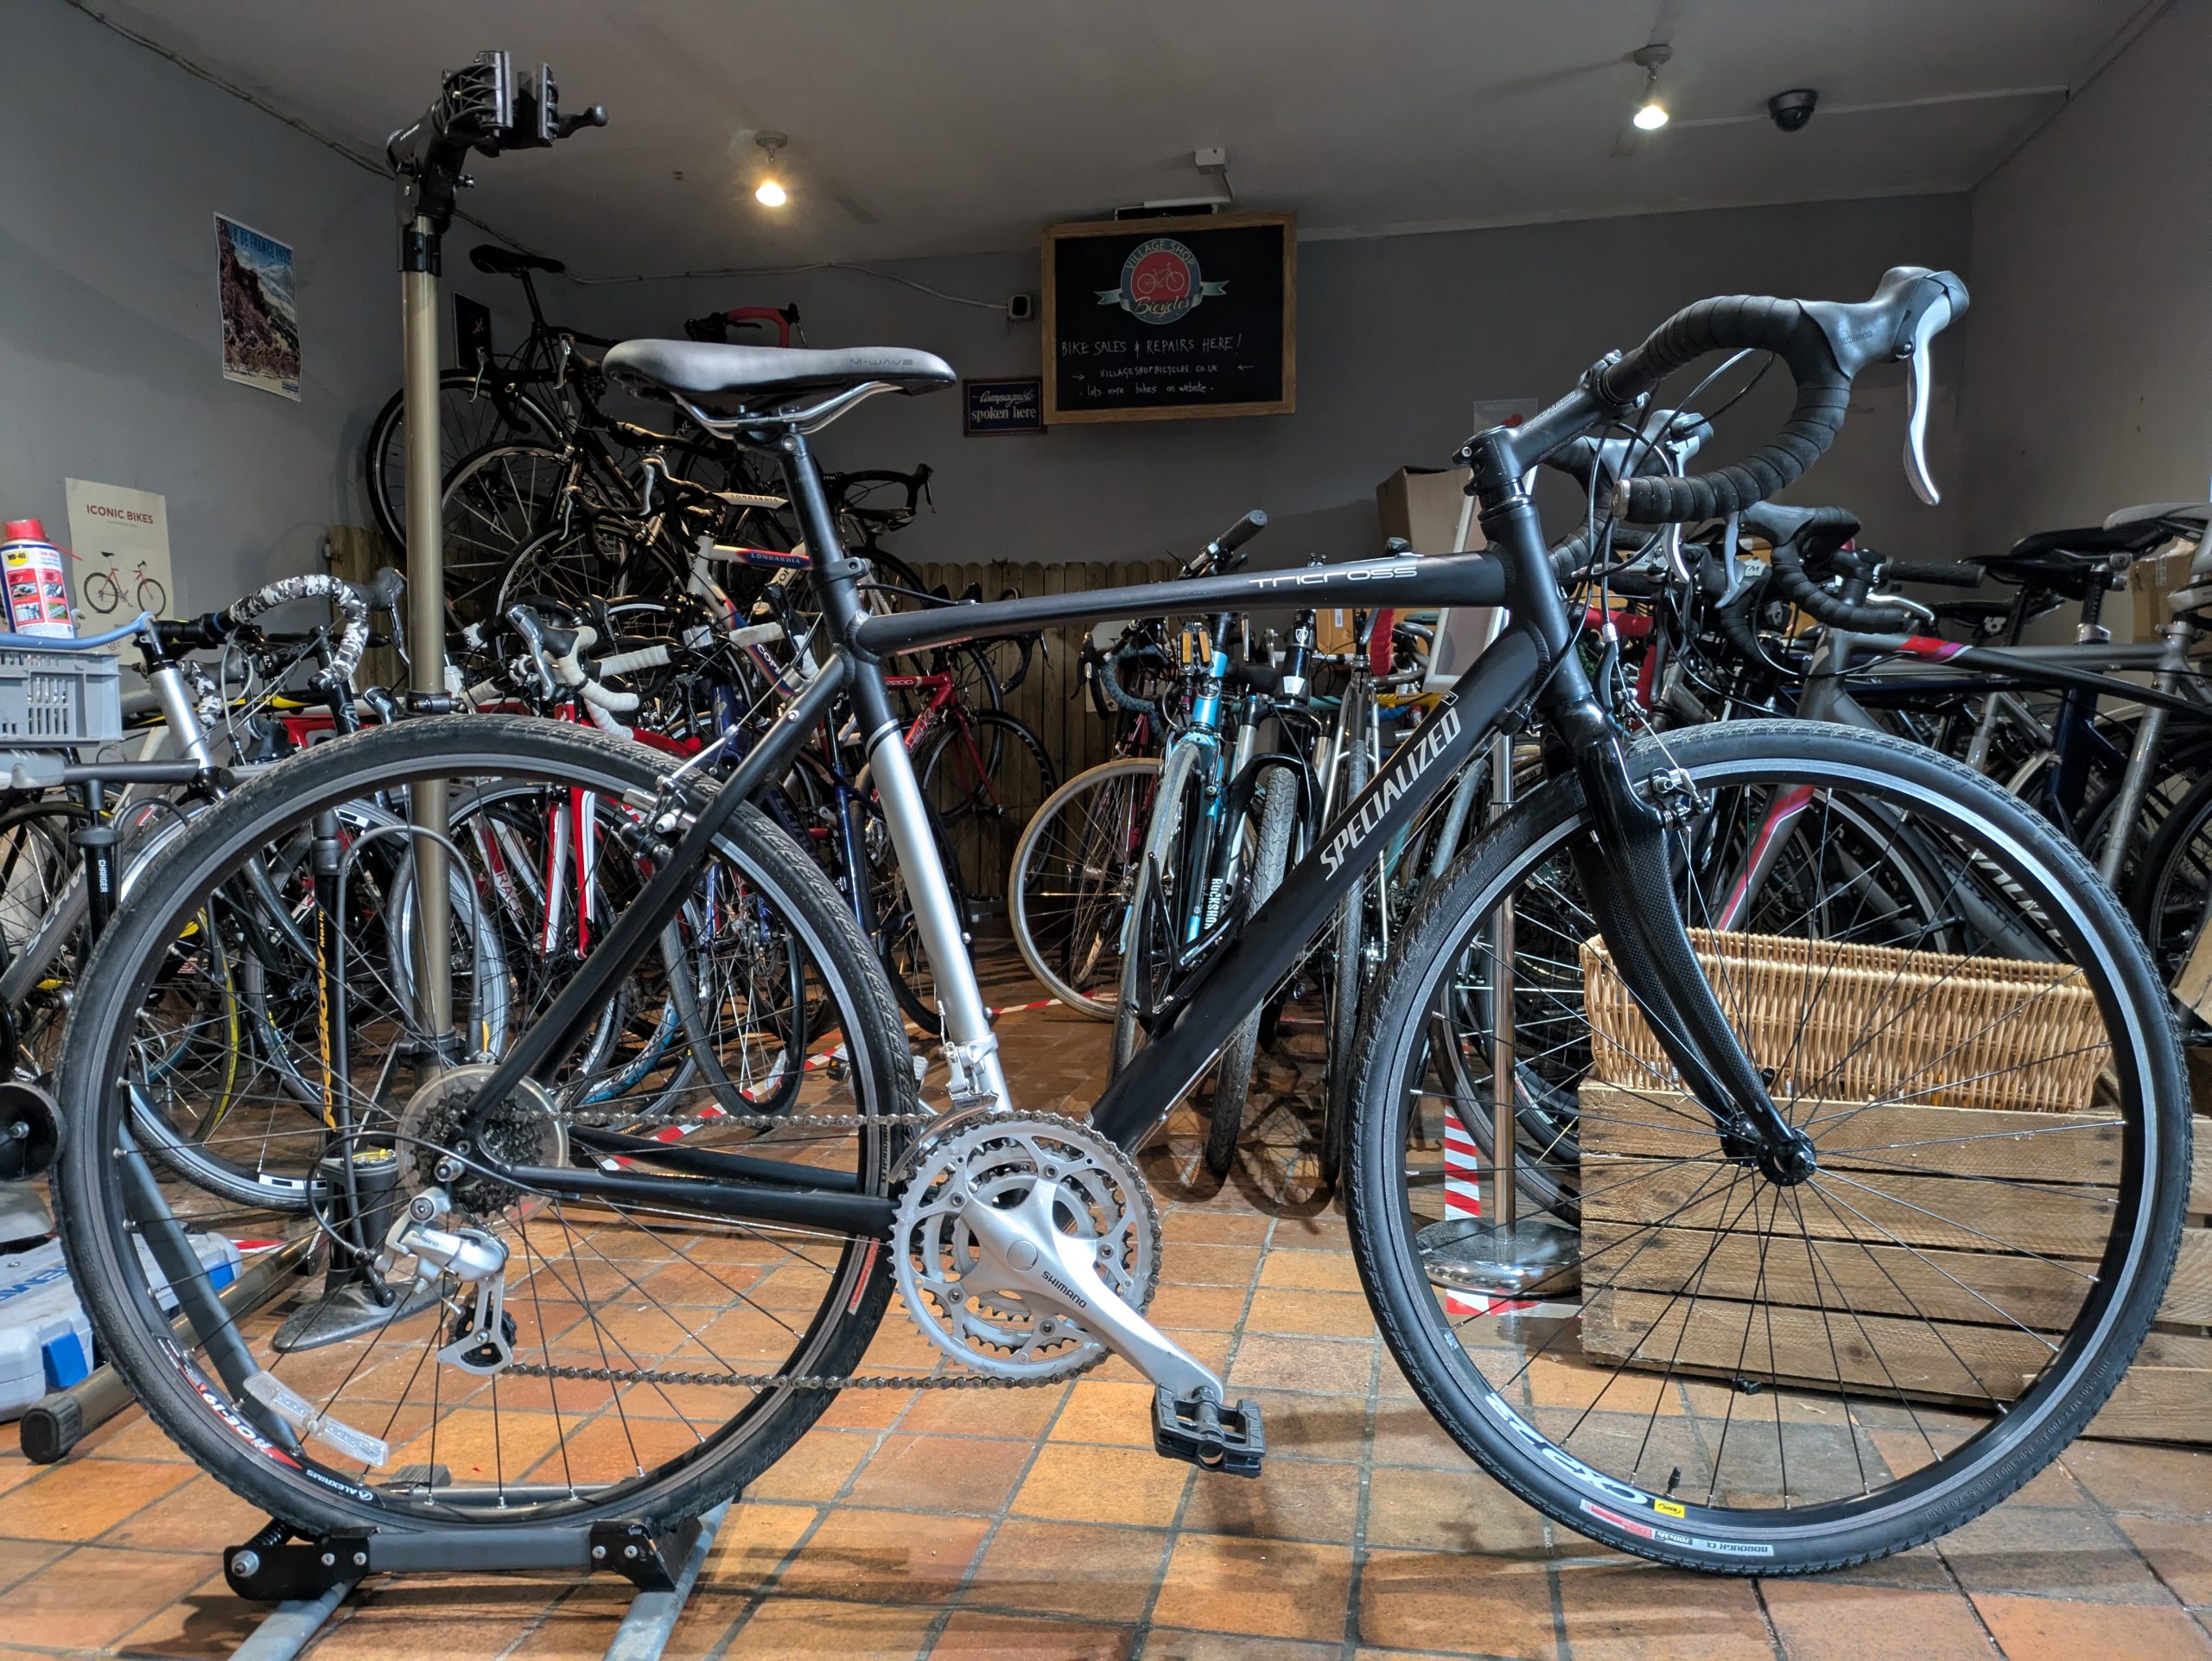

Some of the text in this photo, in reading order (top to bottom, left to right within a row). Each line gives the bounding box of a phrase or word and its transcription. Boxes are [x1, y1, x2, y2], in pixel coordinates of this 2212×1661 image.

[1126, 240, 1195, 270] VILLAGE SHOP
[1135, 296, 1191, 317] Bicycles
[1061, 341, 1089, 357] BIKE
[1094, 340, 1127, 356] SALES
[1146, 339, 1194, 354] REPAIRS
[1135, 383, 1158, 394] bikes
[1166, 385, 1175, 393] on
[970, 405, 1037, 423] spoken here
[86, 504, 124, 519] ICONIC
[127, 511, 154, 525] BIKES
[7, 552, 27, 561] WD-40
[751, 552, 802, 565] LOMBARDIA
[1320, 707, 1461, 881] SPECIALIZED
[98, 859, 109, 893] CHARGER
[1041, 1270, 1087, 1308] SHIMANO
[306, 1469, 355, 1495] ALEXRIMS
[1719, 1543, 1768, 1553] BOROUGH
